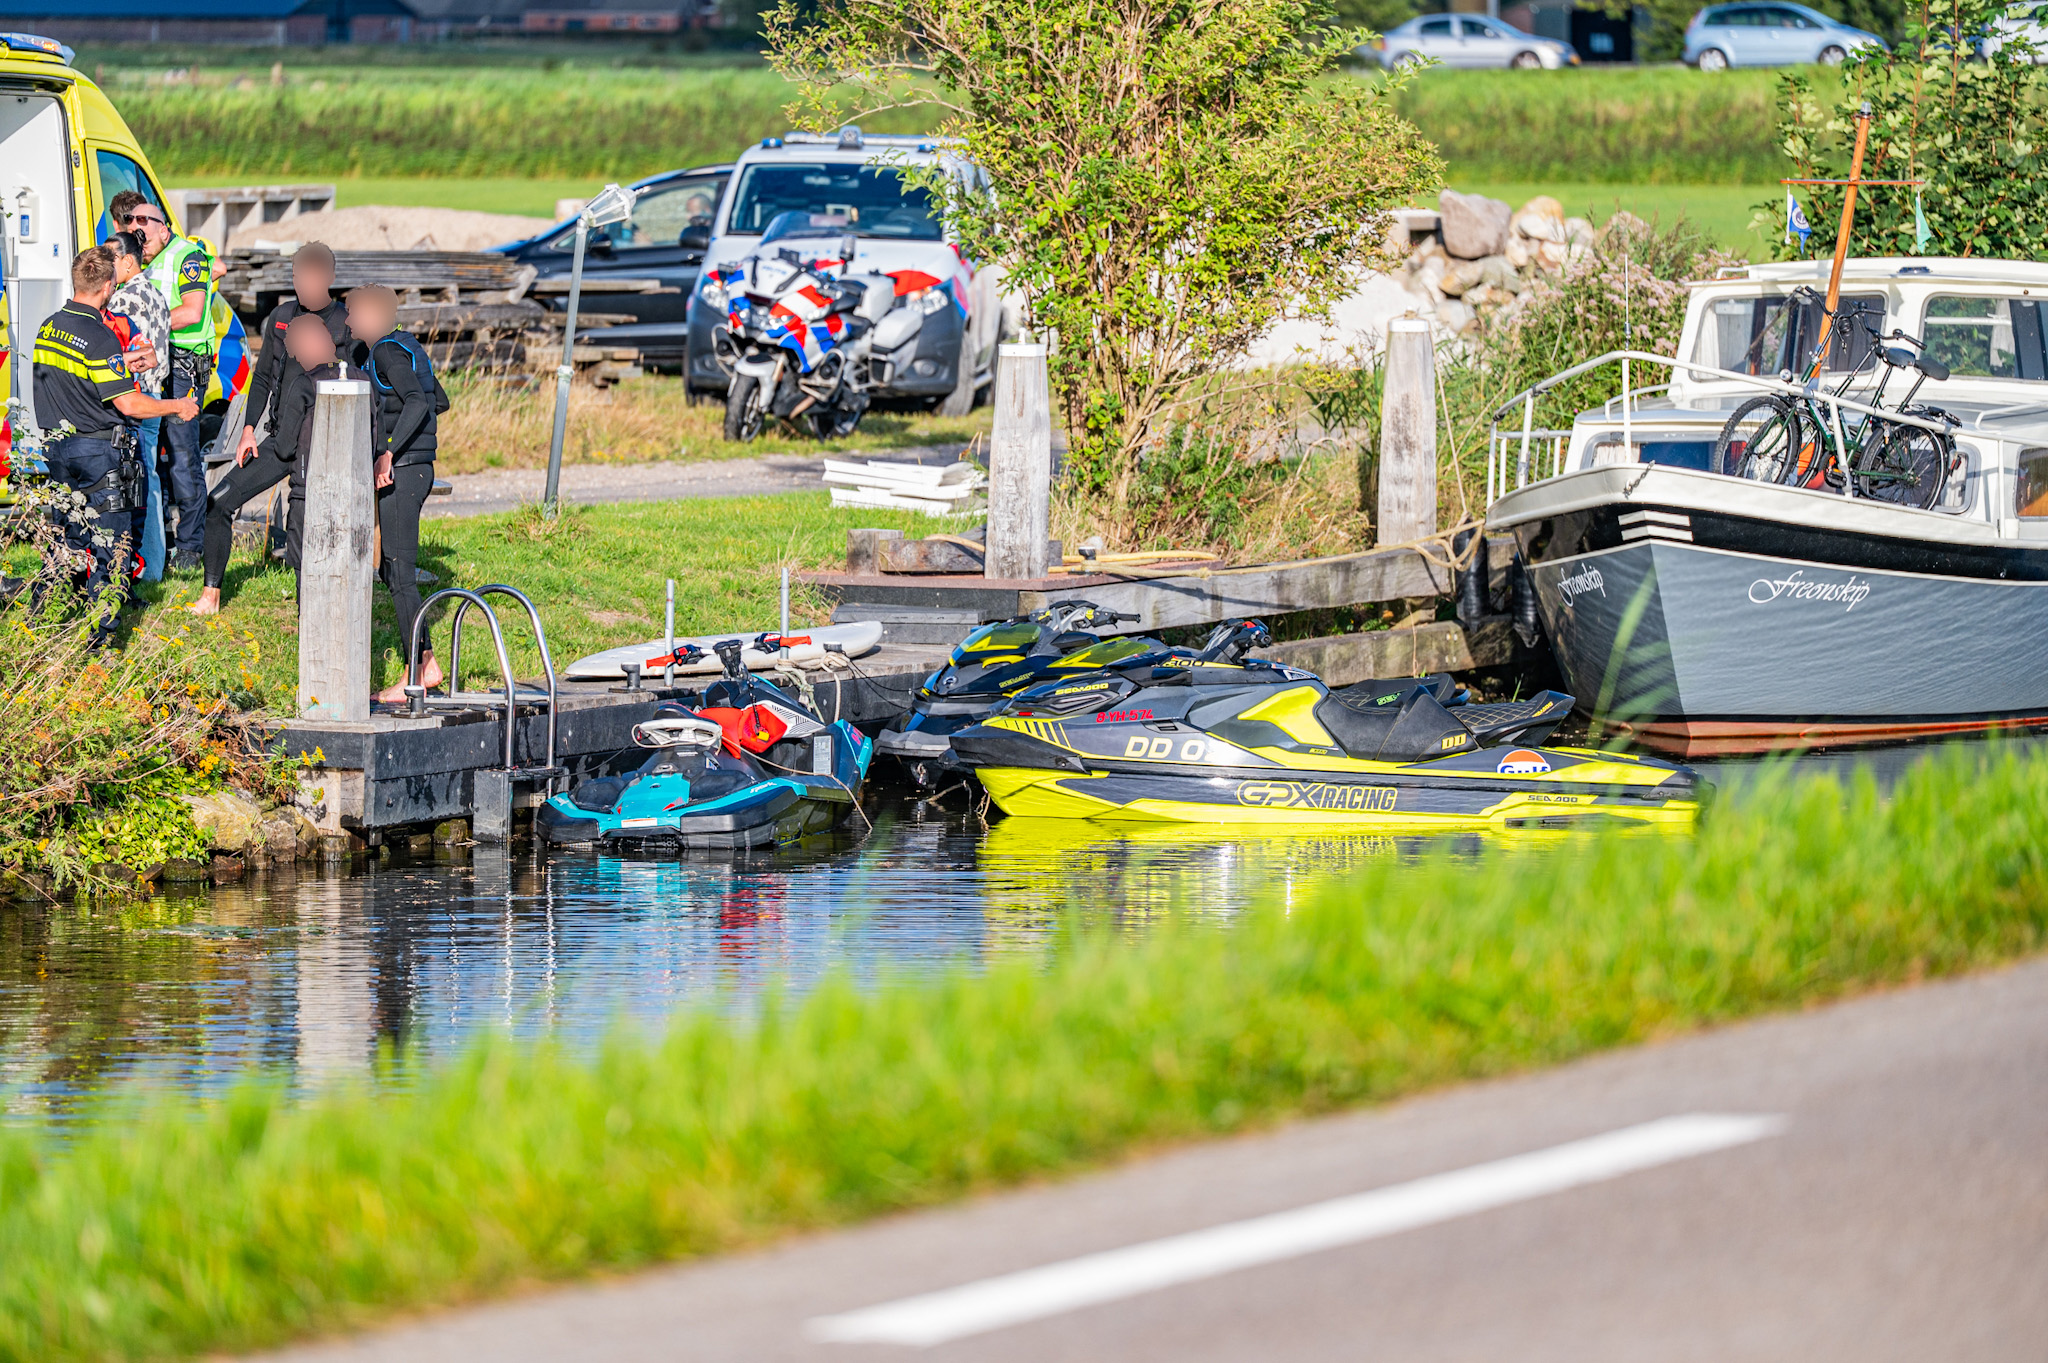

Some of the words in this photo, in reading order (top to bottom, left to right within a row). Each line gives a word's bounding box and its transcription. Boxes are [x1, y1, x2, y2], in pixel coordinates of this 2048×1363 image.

[39, 320, 75, 343] POLITIE
[1557, 563, 1607, 607] Freonskip
[1748, 570, 1870, 612] Freonskip
[1124, 736, 1173, 759] DD
[1441, 733, 1467, 750] DD
[1500, 765, 1548, 774] Glf
[1236, 780, 1326, 808] GPX
[1319, 786, 1398, 812] RACING
